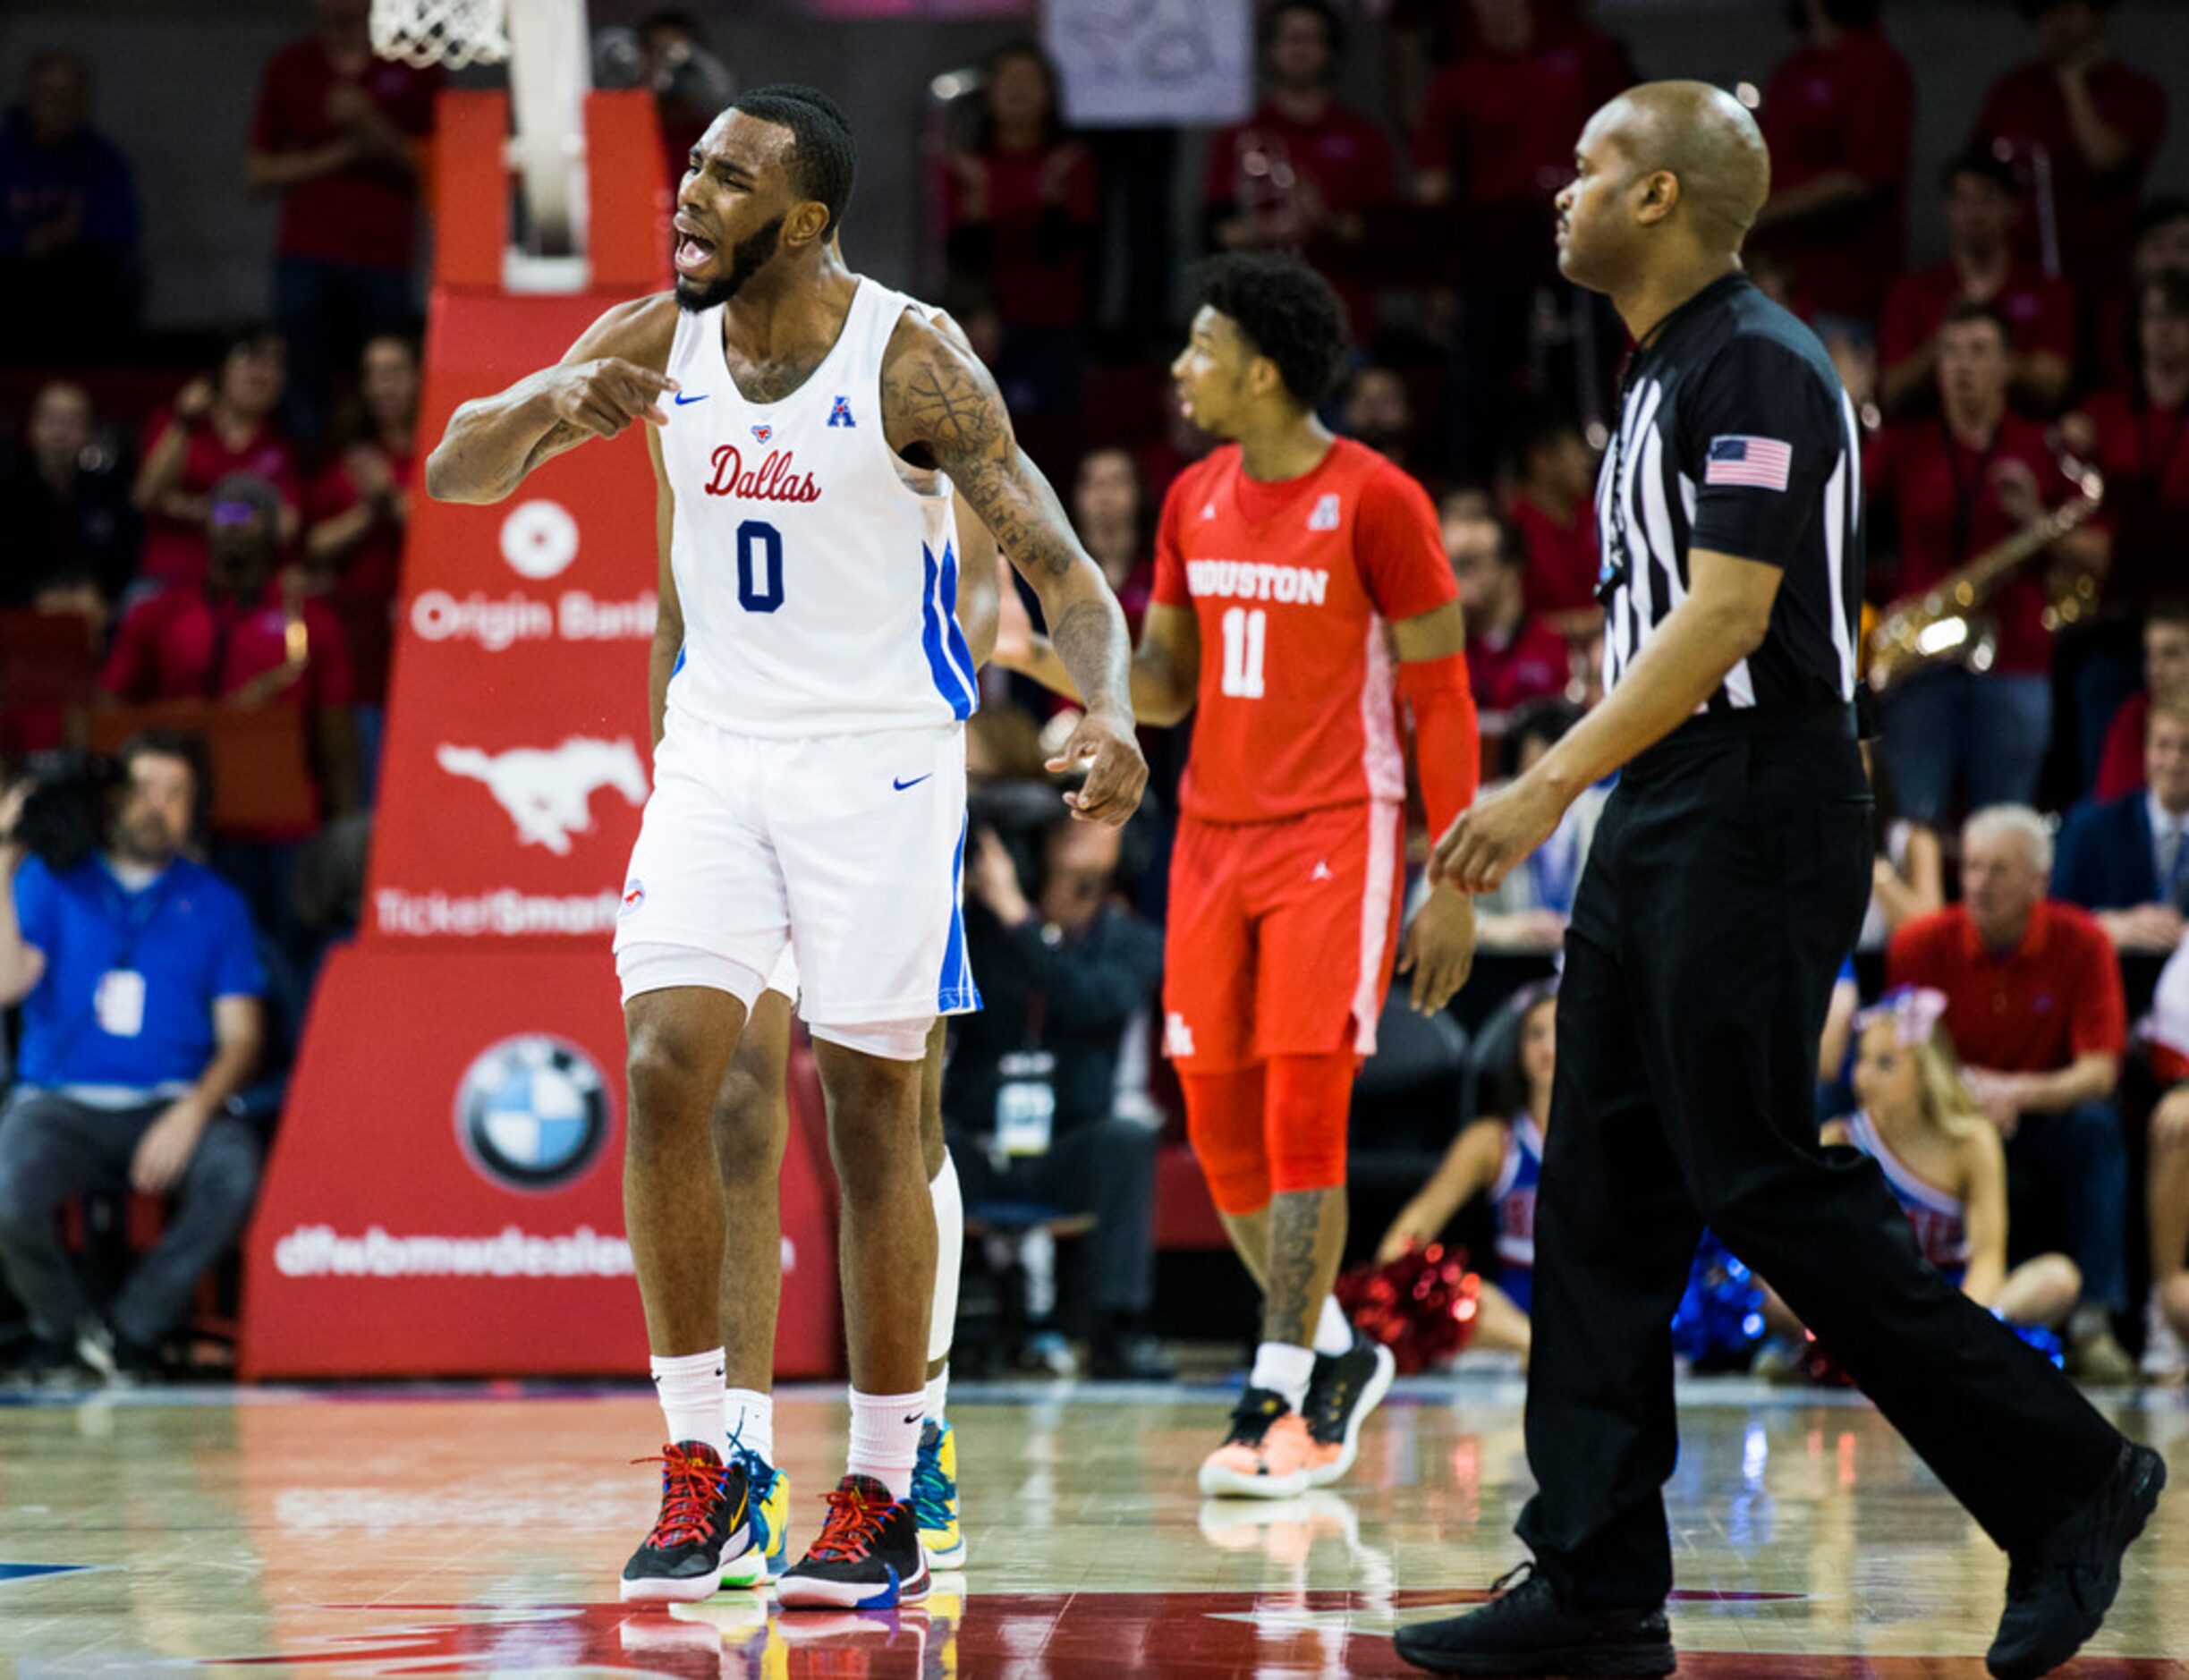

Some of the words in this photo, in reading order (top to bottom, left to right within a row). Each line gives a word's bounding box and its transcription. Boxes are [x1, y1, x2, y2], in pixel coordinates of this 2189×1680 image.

[705, 445, 822, 503] Dallas
[736, 520, 785, 614] 0
[411, 590, 553, 652] Origin
[1222, 607, 1266, 700] 11
[378, 888, 619, 935] TicketSmart
[275, 1225, 795, 1277] dfwbmwdealer
